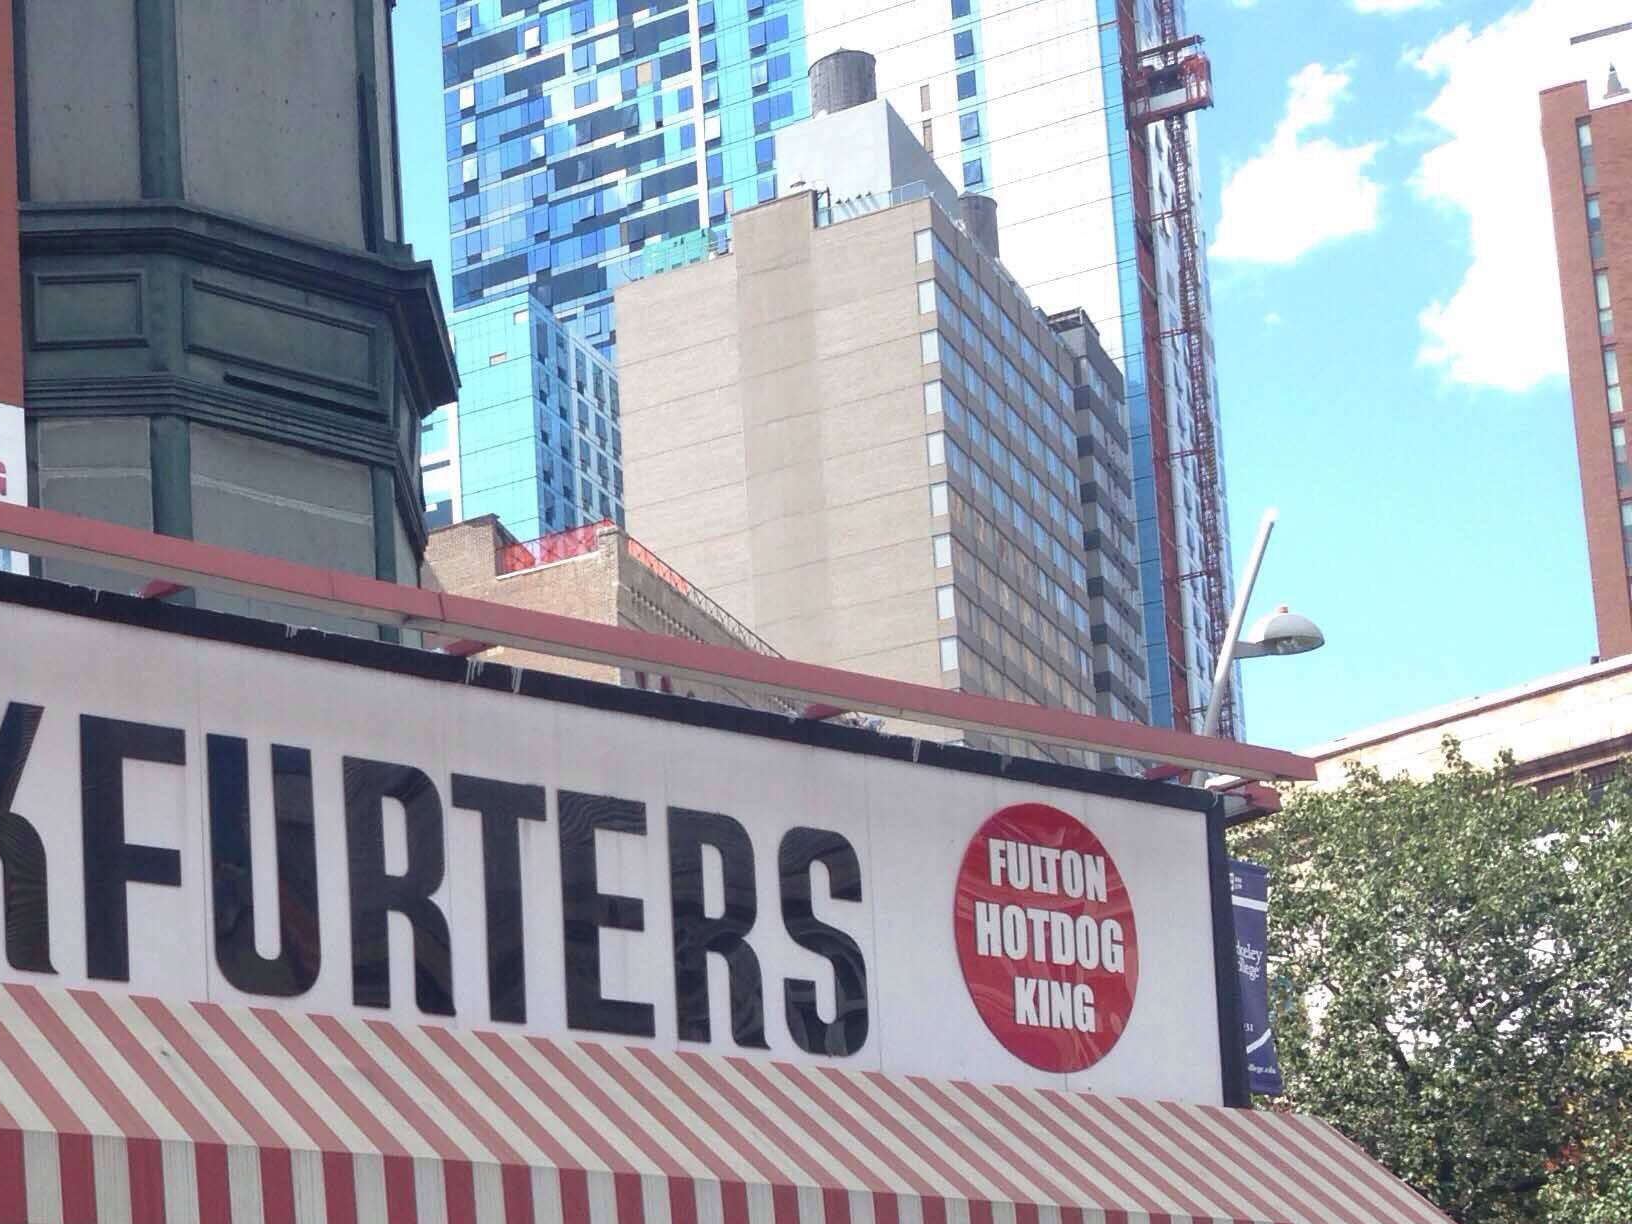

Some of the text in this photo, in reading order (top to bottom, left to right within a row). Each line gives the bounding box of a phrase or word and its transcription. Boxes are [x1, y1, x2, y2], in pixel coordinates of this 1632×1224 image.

[987, 837, 1108, 903] FULTON
[973, 901, 1125, 974] HOTDOG
[1013, 975, 1097, 1033] KING
